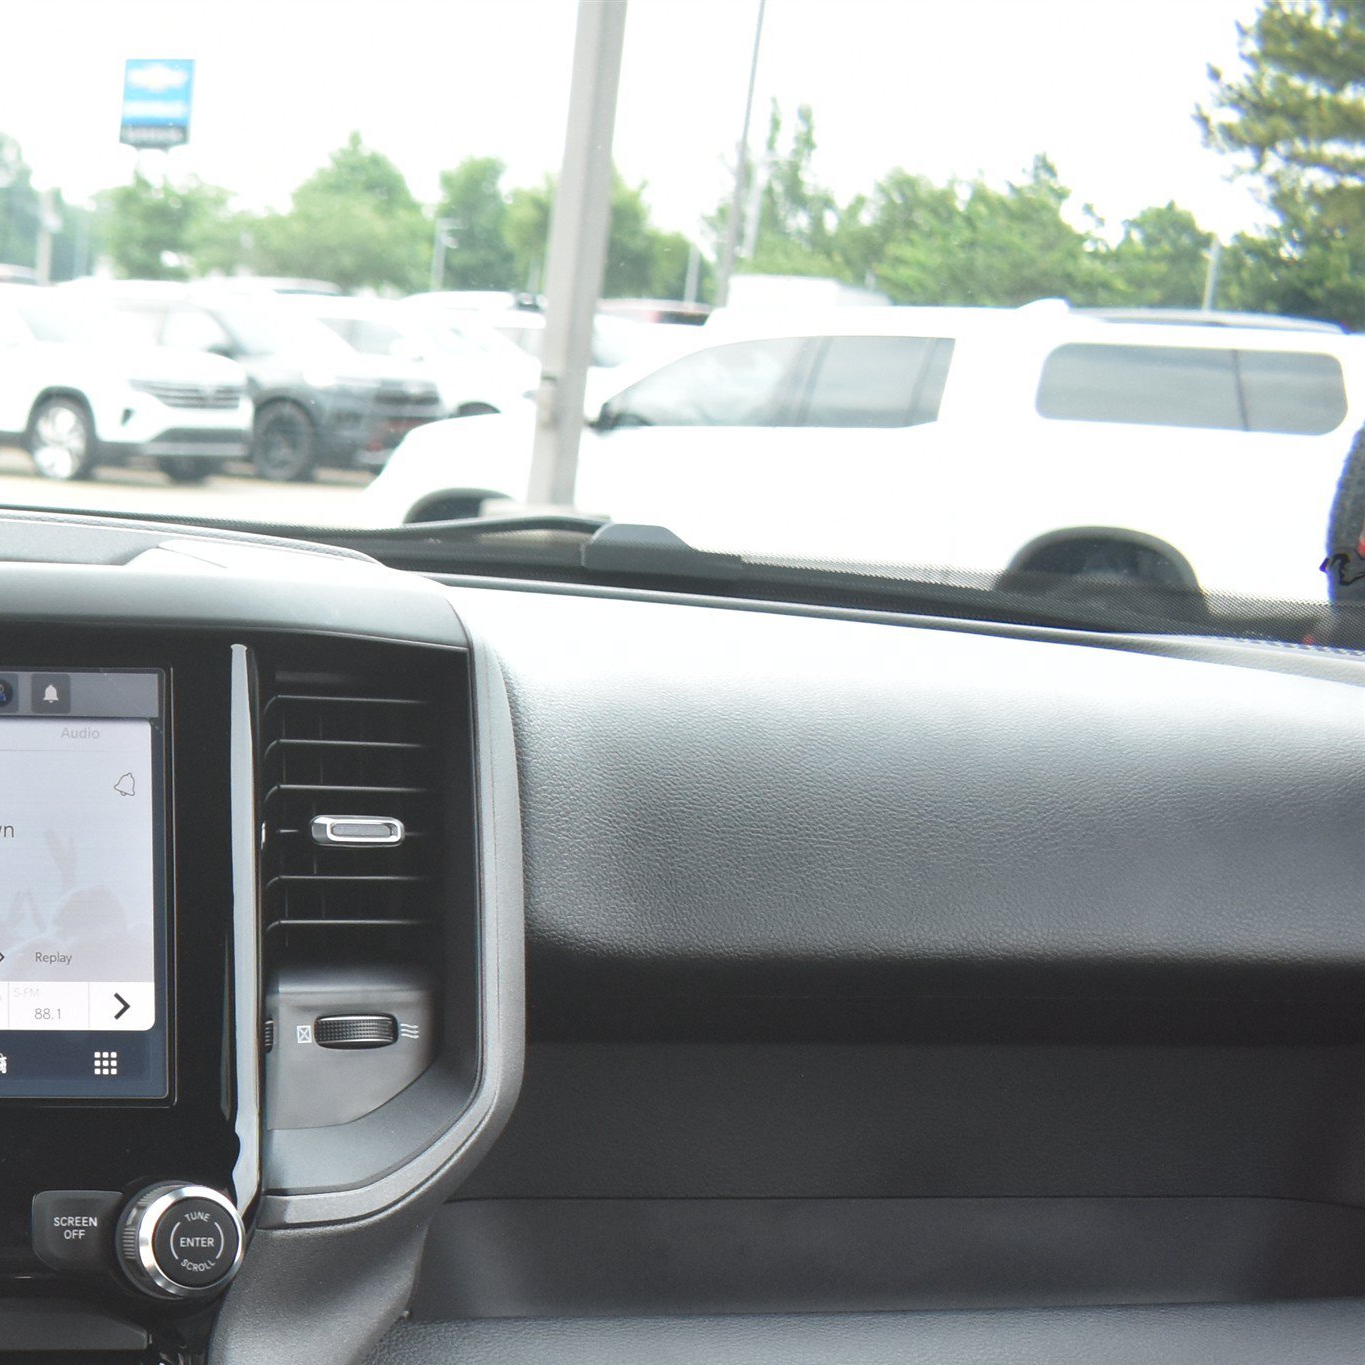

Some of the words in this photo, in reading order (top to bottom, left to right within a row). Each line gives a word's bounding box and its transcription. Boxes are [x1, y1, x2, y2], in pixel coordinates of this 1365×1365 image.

[60, 727, 100, 740] Audio
[34, 951, 73, 966] Replay
[34, 1008, 62, 1020] 88.1
[53, 1216, 98, 1228] SCREEN
[184, 1211, 211, 1224] TUNE
[63, 1229, 86, 1240] OFF
[179, 1236, 215, 1248] ENTER
[180, 1258, 216, 1273] SCROLL
